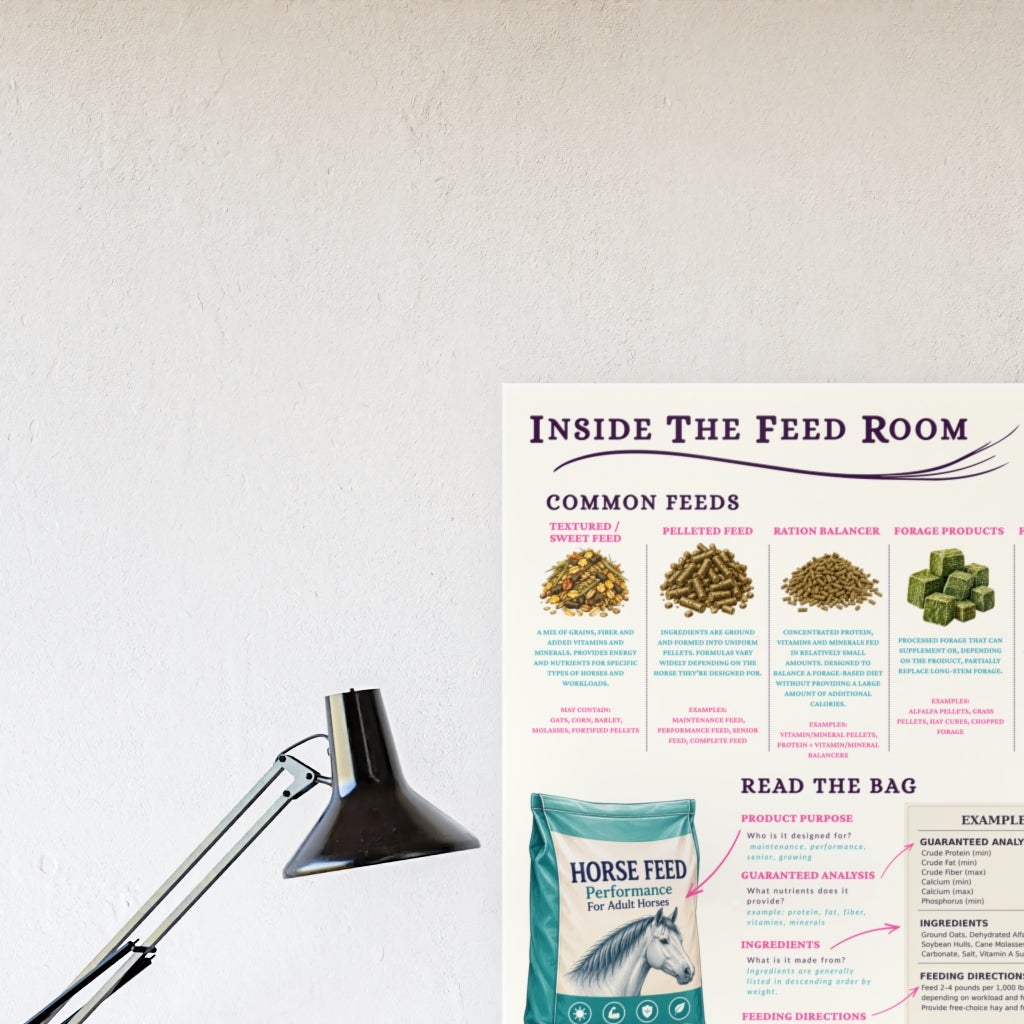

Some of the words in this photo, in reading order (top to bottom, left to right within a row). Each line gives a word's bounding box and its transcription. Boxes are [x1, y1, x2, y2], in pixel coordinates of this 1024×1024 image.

[546, 494, 656, 510] COMMON
[666, 494, 739, 510] FEEDS
[549, 522, 612, 531] TEXTURED
[663, 527, 721, 535] PELLETED
[724, 527, 753, 535] FEED
[774, 527, 816, 535] RATION
[820, 527, 880, 535] BALANCER
[894, 527, 939, 535] FORAGE
[942, 527, 1004, 535] PRODUCTS
[550, 534, 590, 542] SWEET
[592, 534, 622, 543] FEED
[741, 778, 804, 793] READ
[813, 778, 860, 793] THE
[870, 778, 916, 794] BAG
[742, 814, 797, 823] PRODUCT
[800, 814, 853, 822] PURPOSE
[791, 832, 830, 840] designed
[920, 838, 989, 846] GUARANTEED
[570, 860, 639, 883] HORSE
[644, 860, 687, 880] FEED
[952, 878, 971, 886] (min)
[586, 885, 672, 899] Performance
[588, 902, 604, 912] For
[608, 900, 635, 910] Adult
[638, 899, 670, 908] Horses
[922, 898, 963, 906] Phosphorus
[742, 941, 820, 949] INGREDIENTS
[920, 972, 964, 980] FEEDING
[742, 1012, 792, 1021] FEEDING
[795, 1012, 866, 1021] DIRECTIONS
